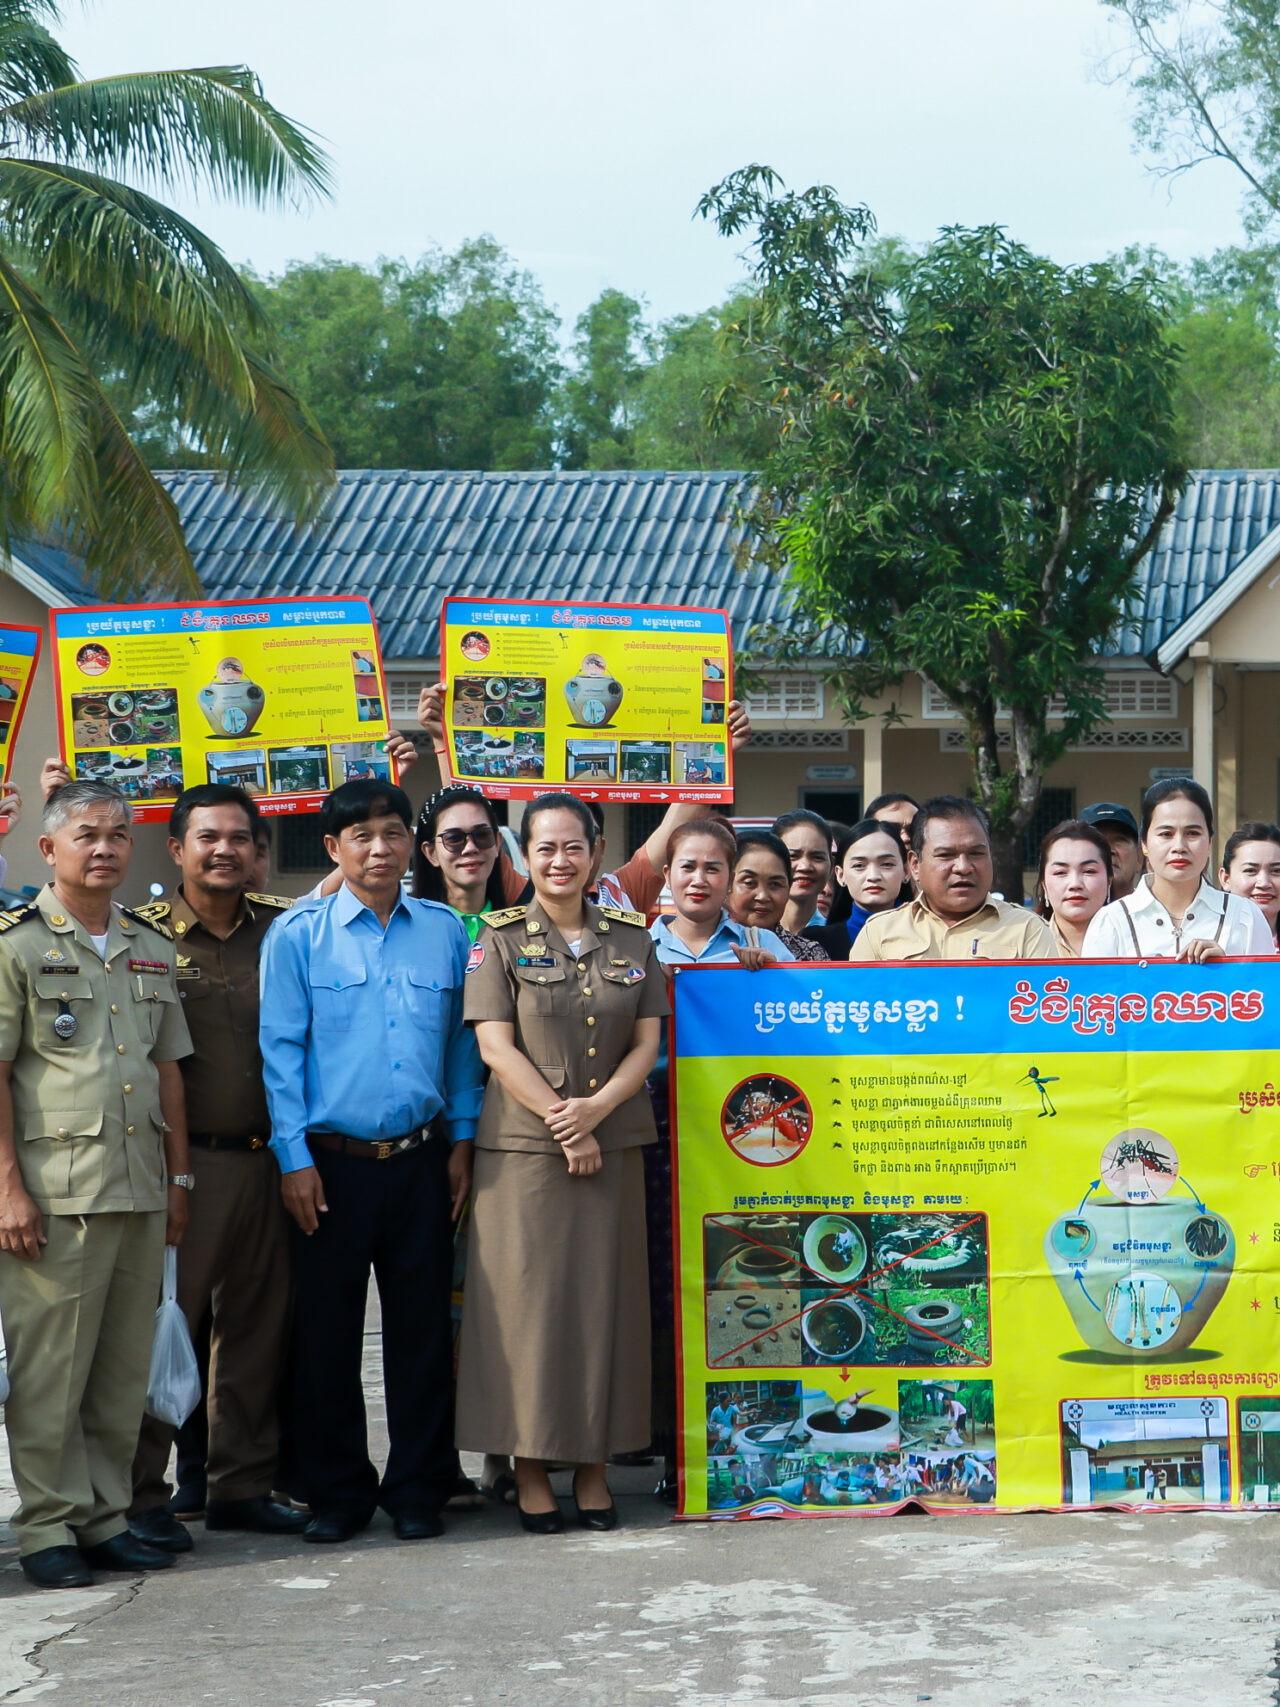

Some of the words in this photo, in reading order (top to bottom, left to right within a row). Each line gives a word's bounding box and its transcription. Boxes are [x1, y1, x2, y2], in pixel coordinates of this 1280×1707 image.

[754, 988, 940, 1034] ប្រយ័ត្នមូសខ្លា
[955, 995, 964, 1021] !
